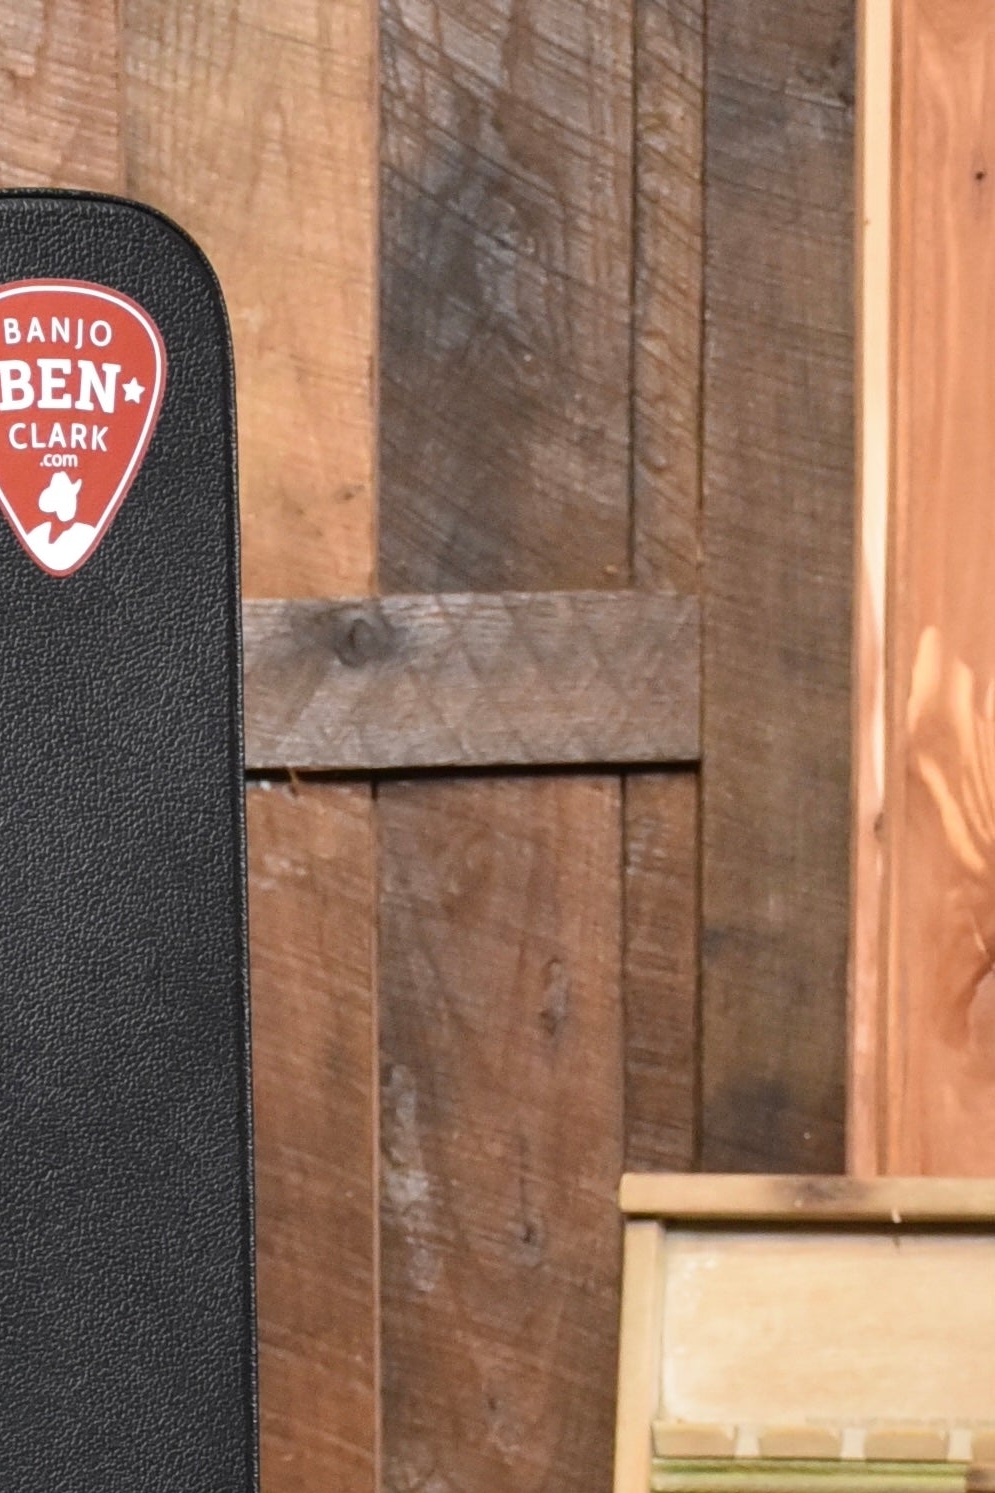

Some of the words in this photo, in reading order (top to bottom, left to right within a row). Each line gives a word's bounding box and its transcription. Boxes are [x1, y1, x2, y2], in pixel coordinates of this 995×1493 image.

[3, 317, 112, 350] BANJO
[8, 422, 109, 452] CLARK
[39, 453, 78, 468] .com
